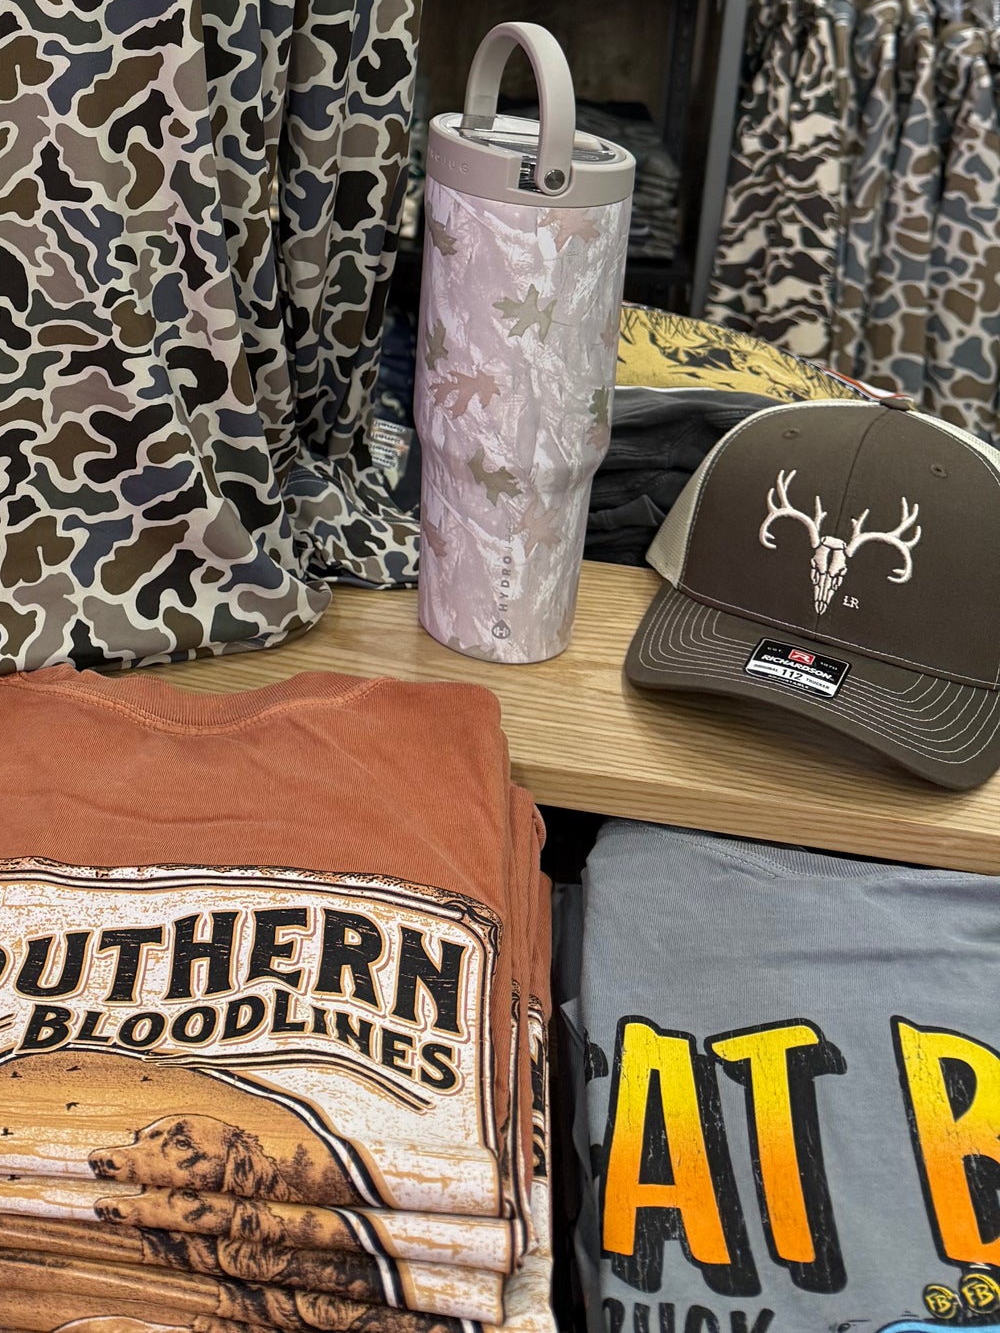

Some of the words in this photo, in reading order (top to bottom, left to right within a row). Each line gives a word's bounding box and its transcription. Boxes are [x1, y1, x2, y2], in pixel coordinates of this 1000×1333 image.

[842, 595, 860, 609] LR
[761, 654, 834, 680] RICHARDSON
[782, 669, 803, 681] 112
[15, 990, 465, 1095] BLOODLINES
[588, 1016, 840, 1281] AT
